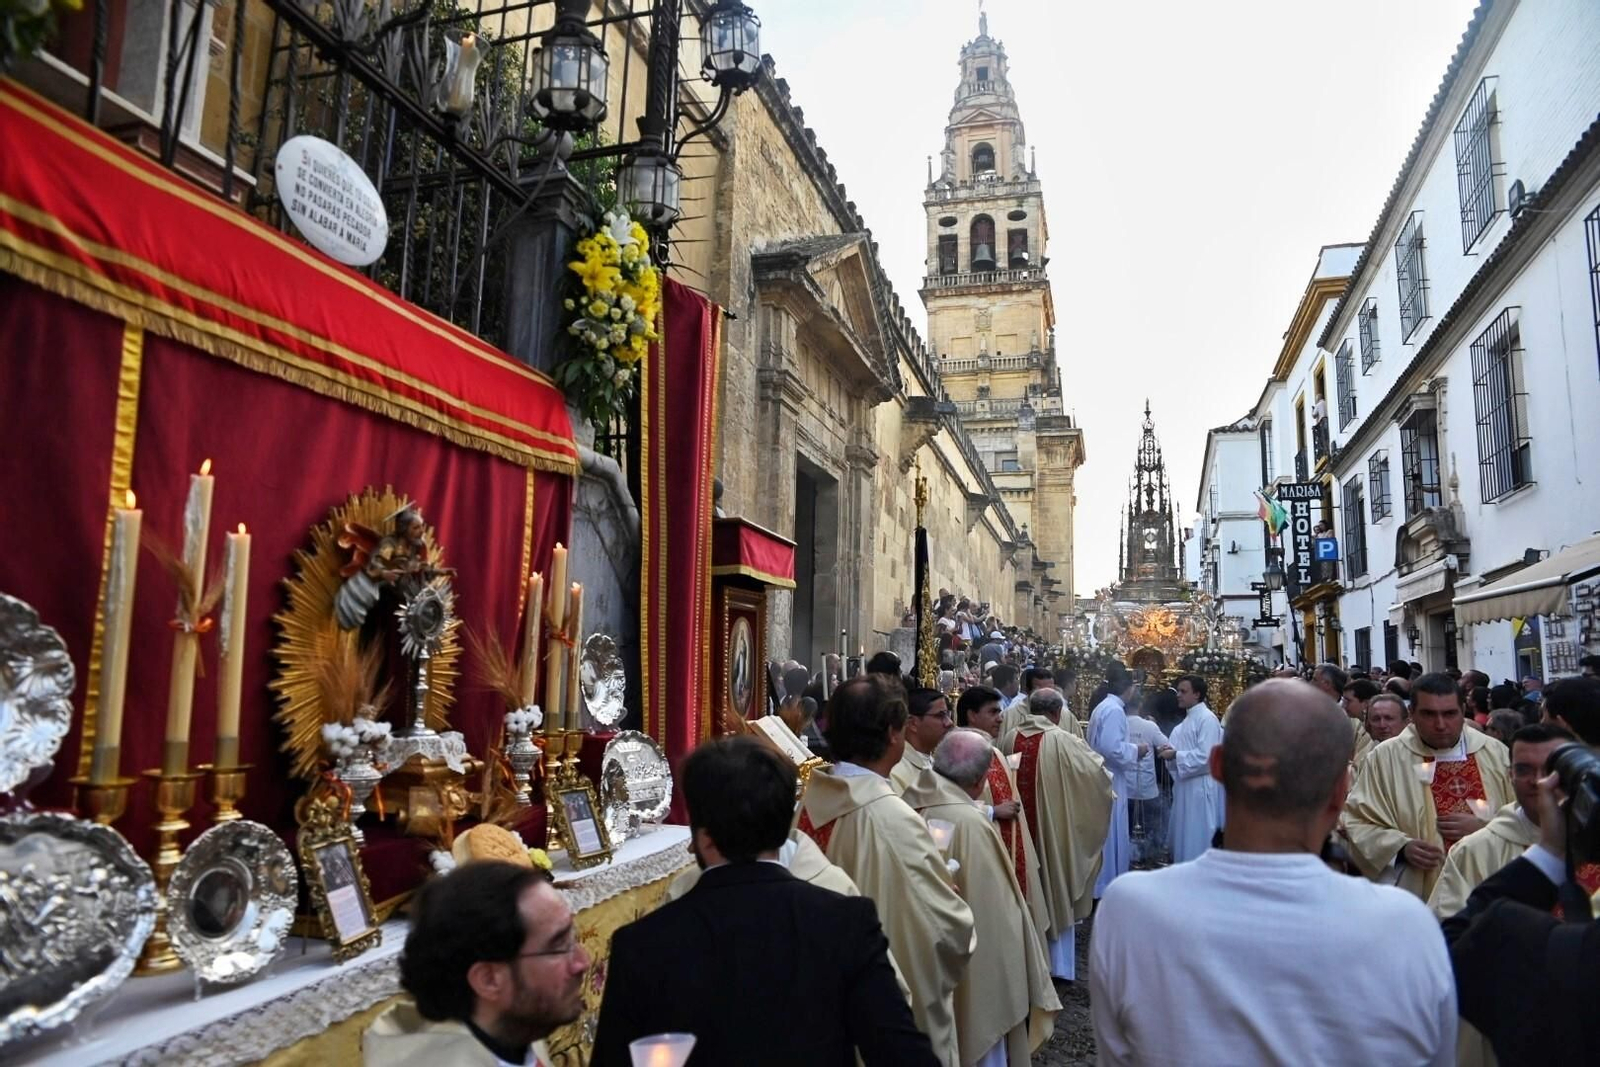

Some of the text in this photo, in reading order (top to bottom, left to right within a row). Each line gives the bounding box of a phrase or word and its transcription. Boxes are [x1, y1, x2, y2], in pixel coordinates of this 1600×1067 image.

[297, 166, 306, 181] SE
[309, 173, 344, 204] CONVIERTA
[346, 197, 354, 210] EN
[313, 160, 340, 187] QUIERES
[341, 178, 354, 195] QUE
[291, 199, 367, 253] SIN ALABAR A MARIA
[295, 182, 371, 240] NO PASARAS PECADOR
[1280, 485, 1322, 498] MARISA
[1295, 501, 1311, 584] HOTEL
[1319, 541, 1334, 558] P
